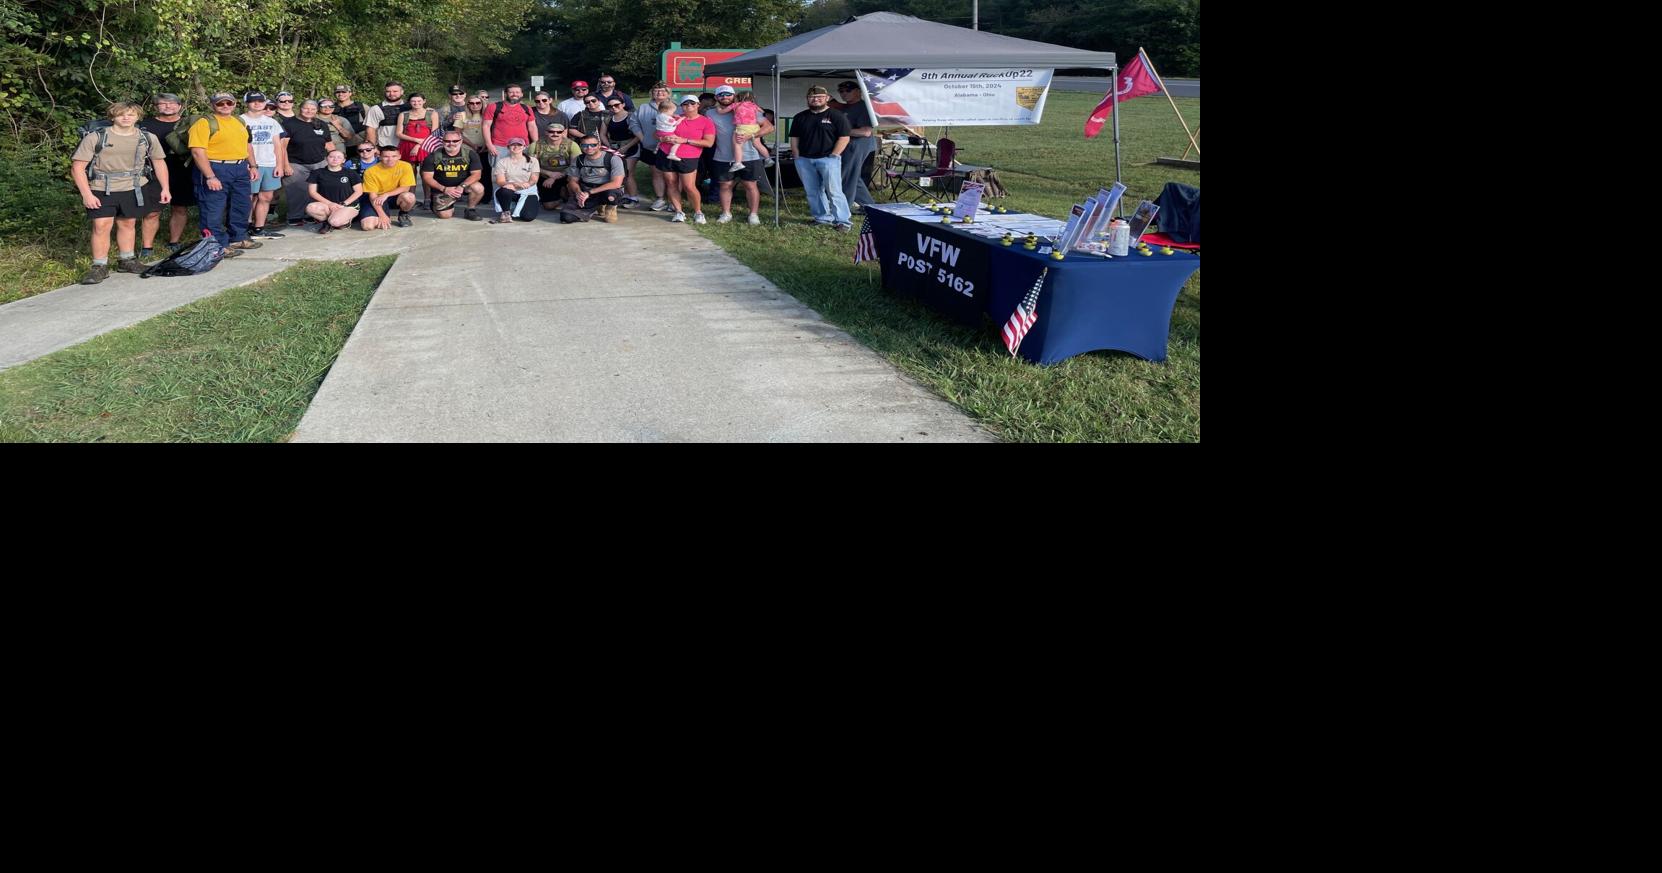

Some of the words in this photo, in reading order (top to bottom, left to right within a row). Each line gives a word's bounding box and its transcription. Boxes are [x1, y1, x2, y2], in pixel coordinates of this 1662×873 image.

[921, 72, 937, 80] 9th
[436, 164, 468, 172] ARMY
[917, 232, 961, 268] VFW
[898, 251, 933, 275] POST
[937, 268, 975, 298] 5162
